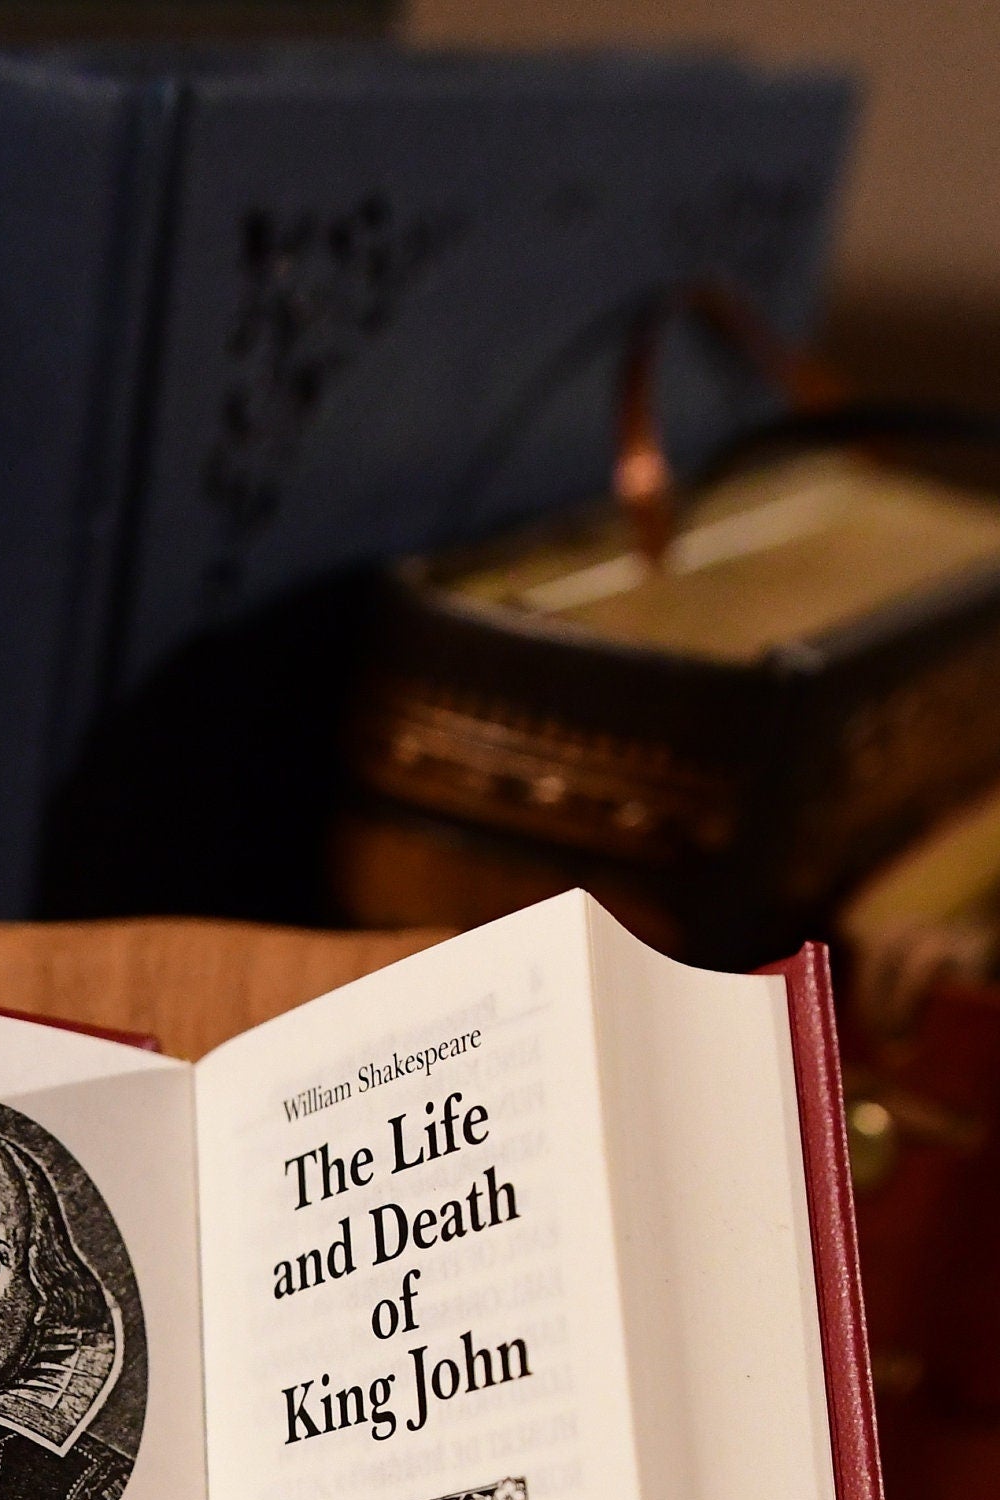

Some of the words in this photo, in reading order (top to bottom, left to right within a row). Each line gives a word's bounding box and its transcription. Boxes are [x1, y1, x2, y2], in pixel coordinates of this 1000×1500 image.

[283, 1079, 352, 1123] William
[357, 1029, 483, 1094] Shakespeare
[284, 1142, 375, 1211] The
[388, 1091, 490, 1174] Life
[273, 1216, 357, 1300] and
[369, 1166, 521, 1267] Death
[371, 1269, 422, 1340] of
[282, 1373, 397, 1445] King
[406, 1331, 533, 1431] John
